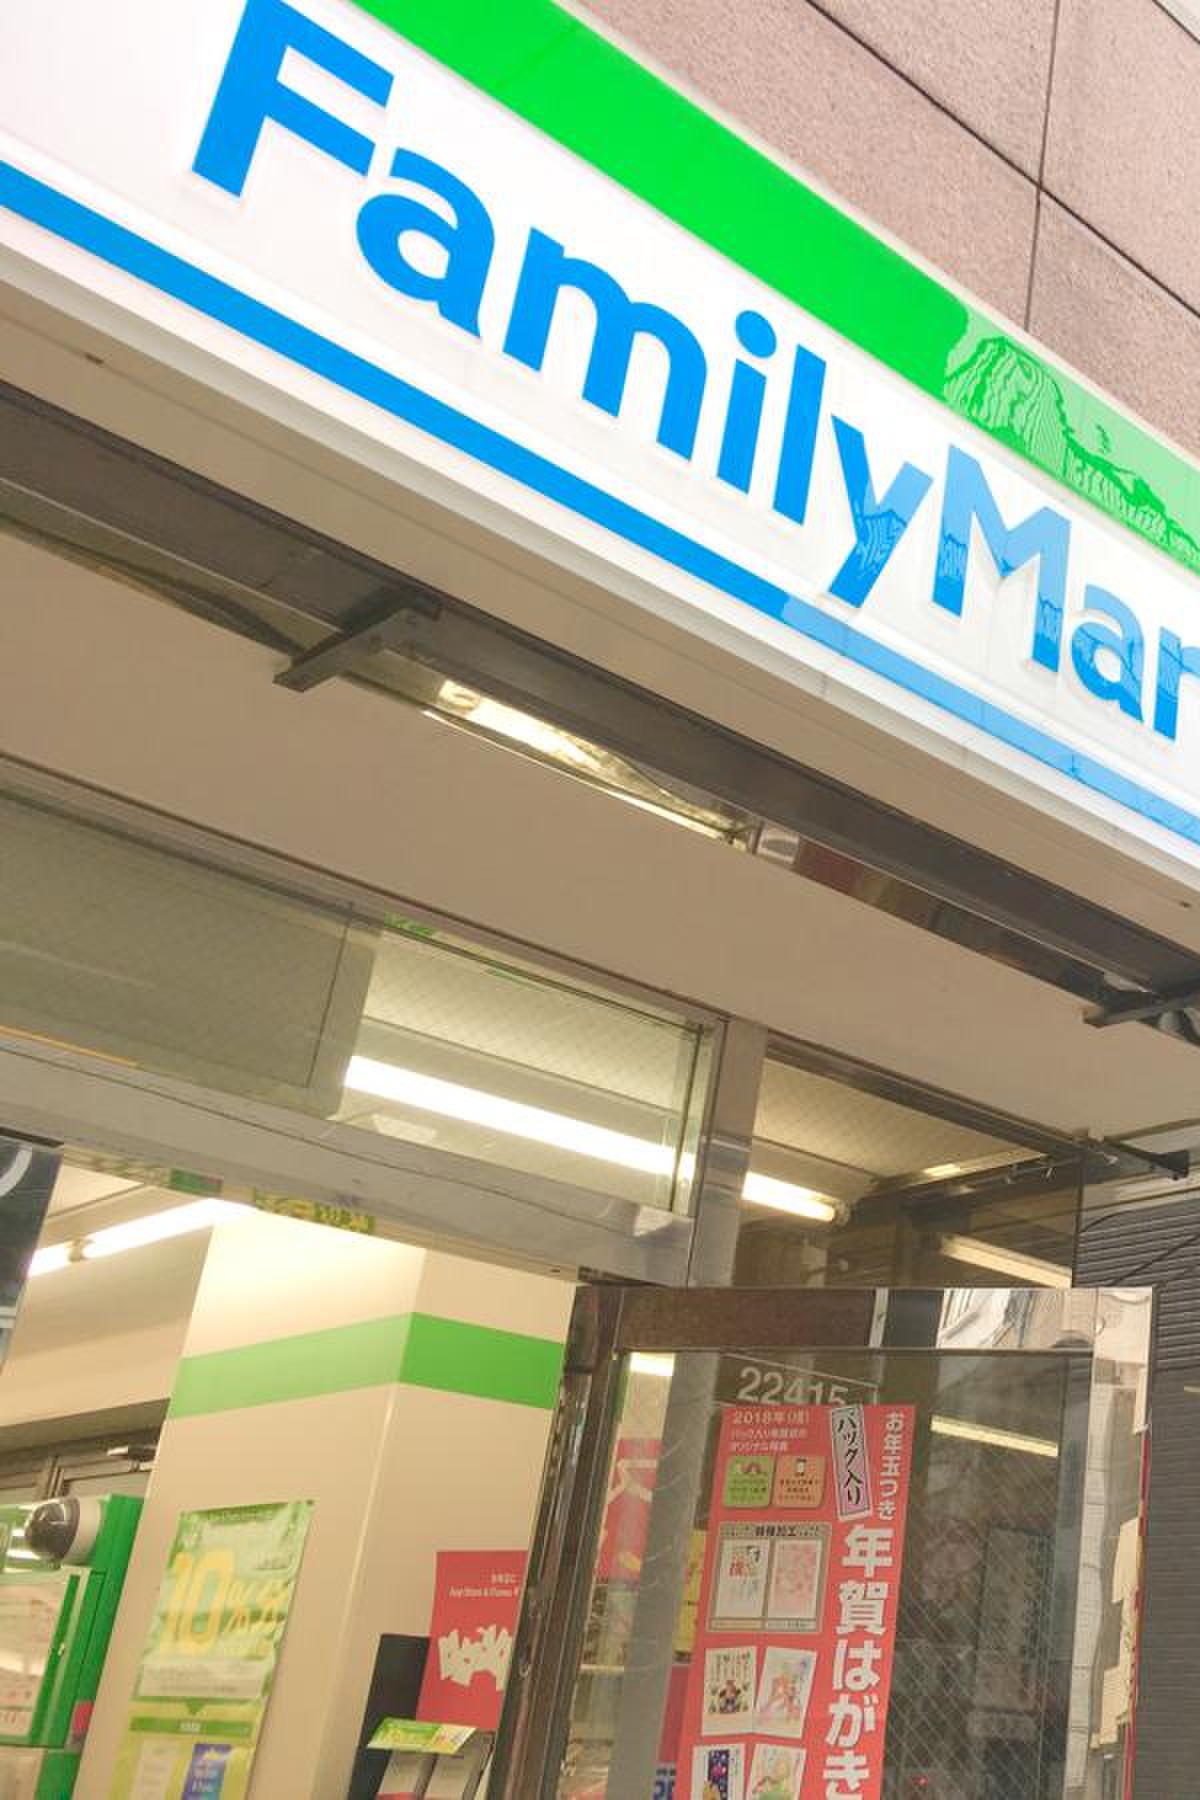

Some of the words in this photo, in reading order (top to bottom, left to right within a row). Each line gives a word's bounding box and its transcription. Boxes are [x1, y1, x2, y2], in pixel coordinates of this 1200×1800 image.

[879, 1412, 904, 1520] お年玉つき
[822, 1524, 895, 1800] 年賀はがき
